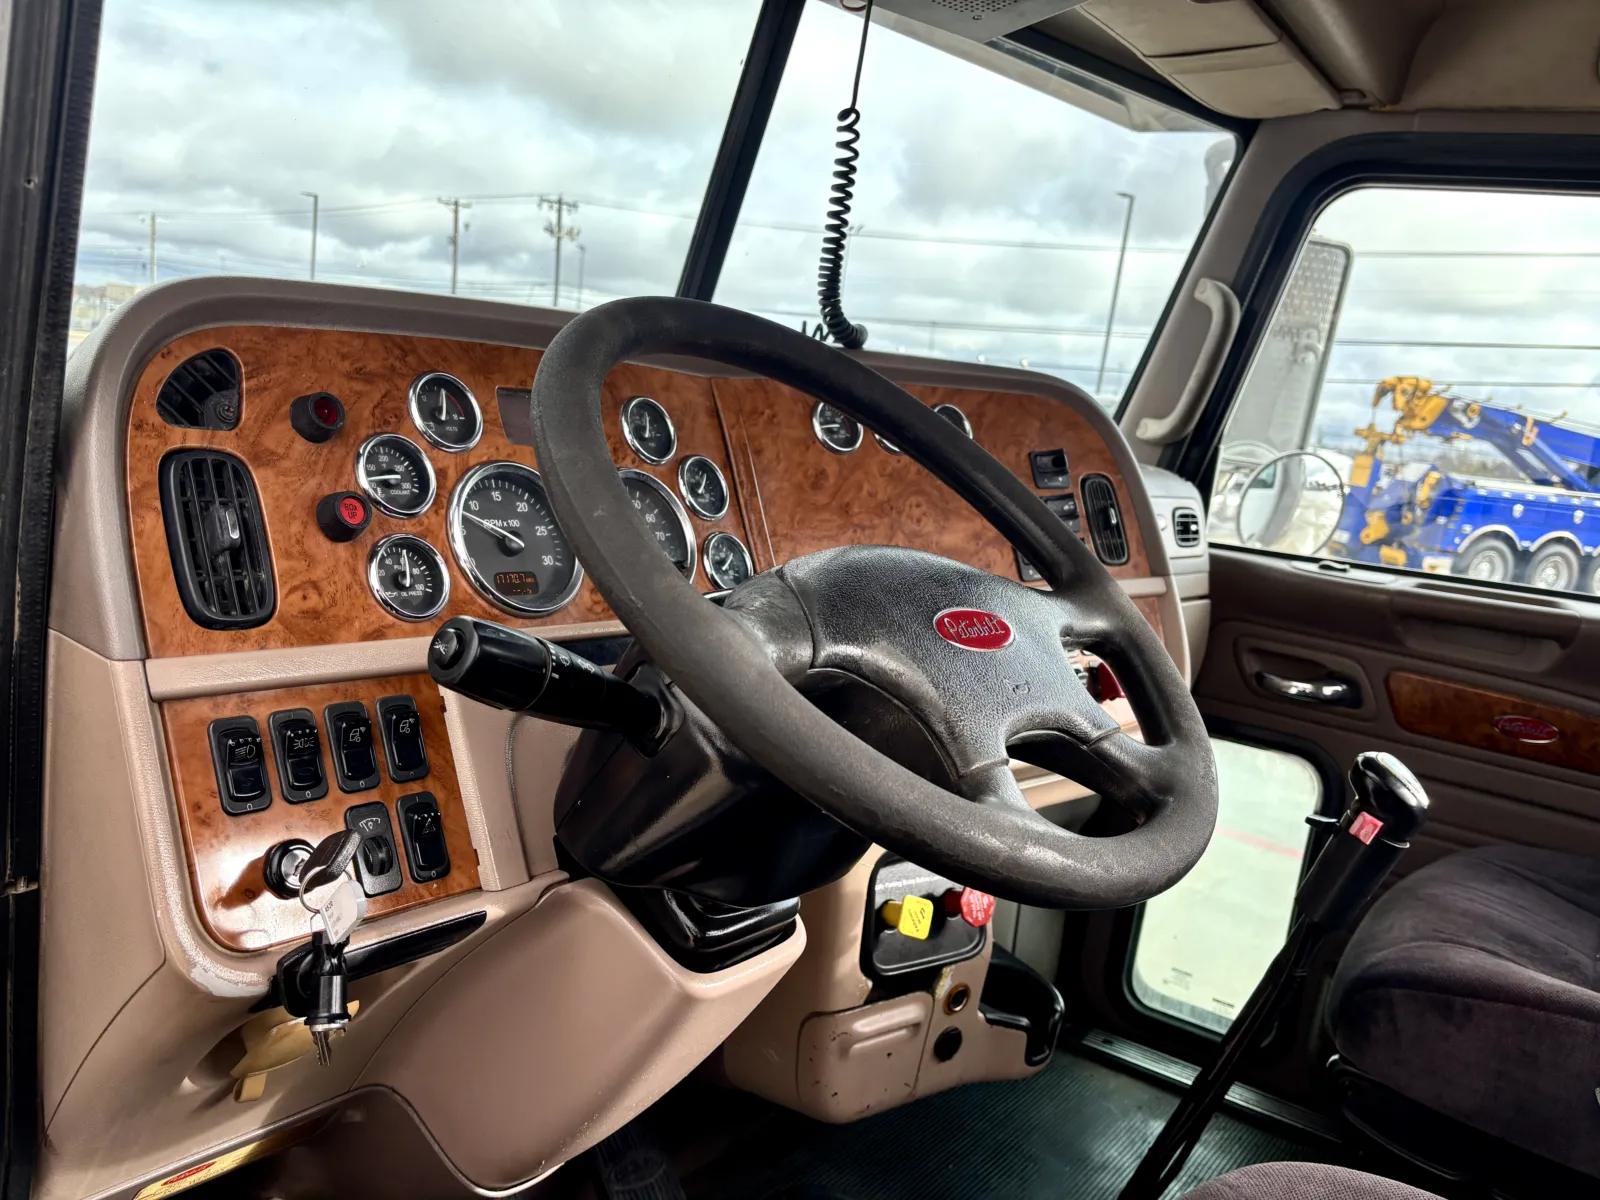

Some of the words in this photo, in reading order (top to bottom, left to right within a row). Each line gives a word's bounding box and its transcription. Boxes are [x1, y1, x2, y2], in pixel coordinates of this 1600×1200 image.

[394, 464, 405, 472] 250
[401, 482, 412, 490] 300
[491, 491, 502, 501] 15
[344, 503, 359, 511] BOX
[468, 500, 479, 511] 10
[516, 502, 528, 512] 20
[347, 511, 358, 519] UP
[645, 513, 656, 523] 60
[535, 526, 547, 536] 25
[655, 531, 666, 541] 70
[541, 555, 554, 566] 30
[378, 569, 385, 577] 20
[414, 583, 425, 591] 100
[943, 616, 1006, 642] Peterbilt
